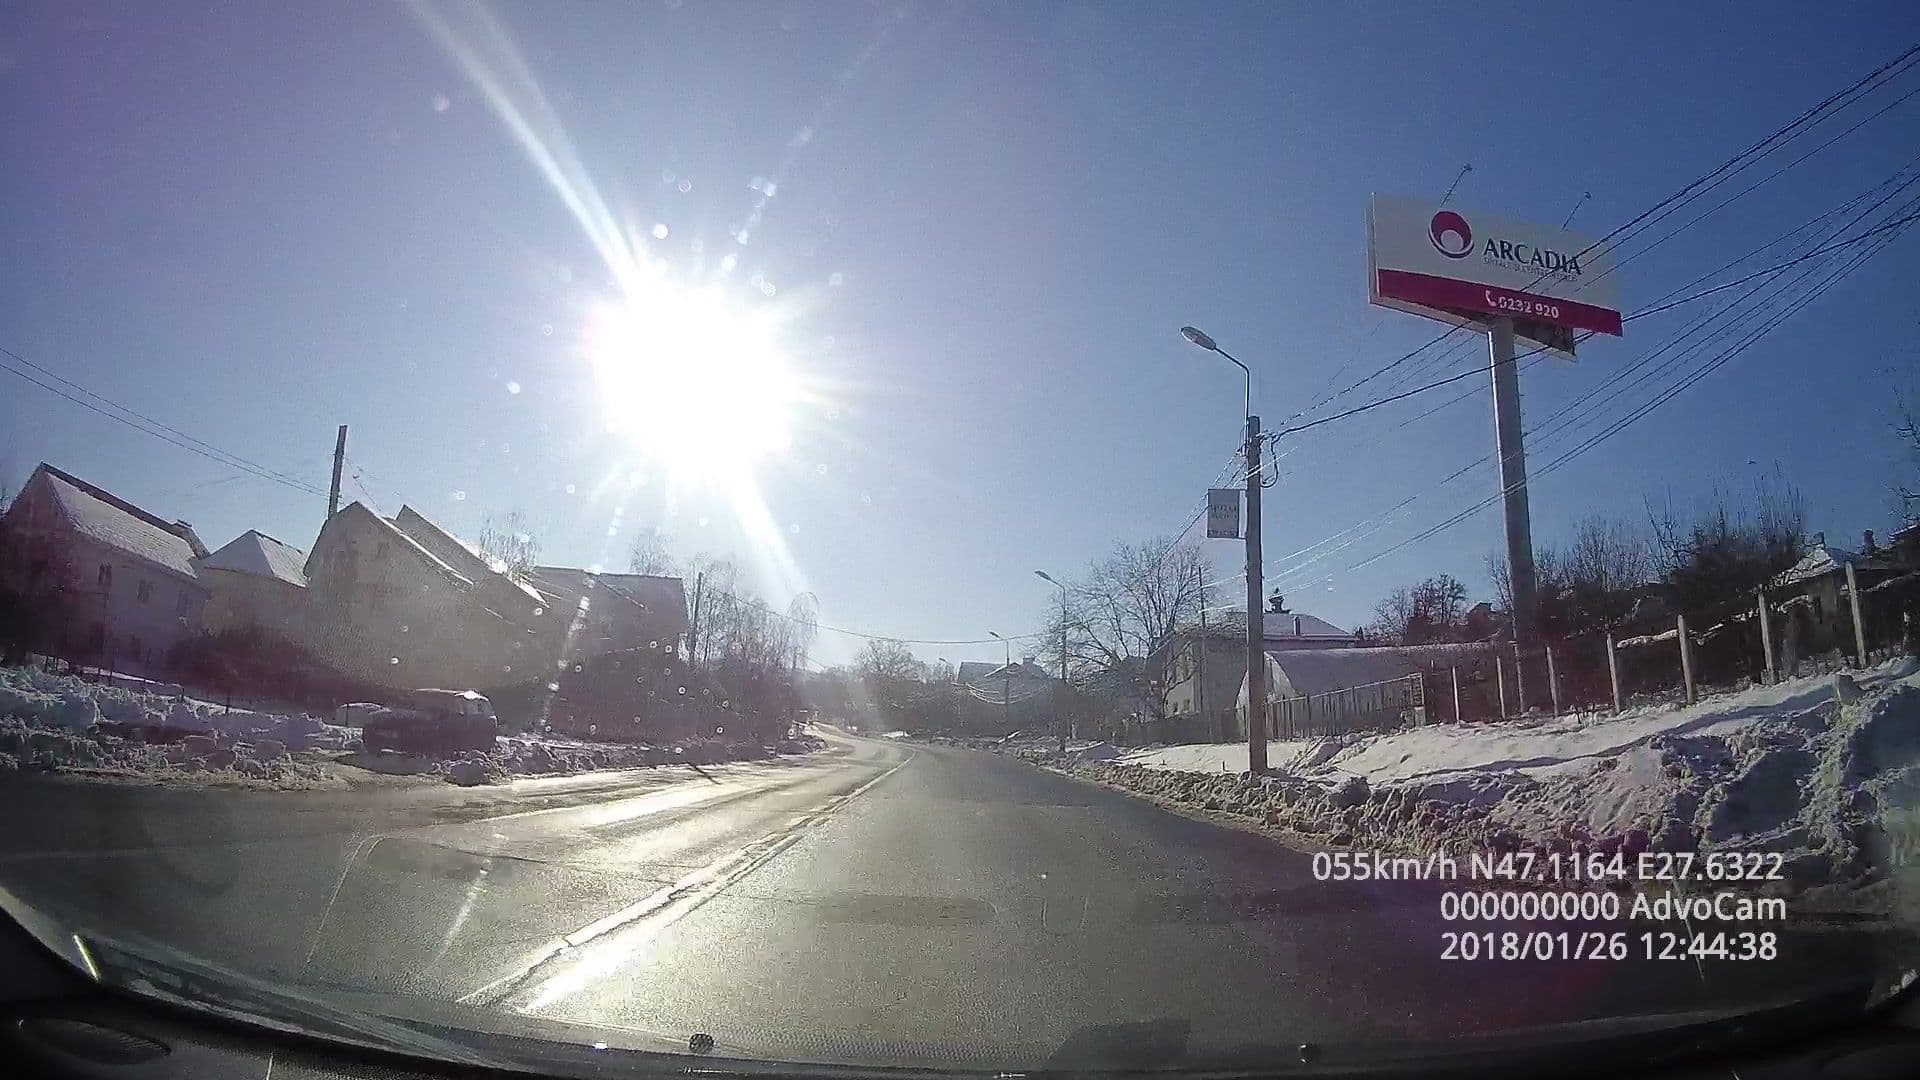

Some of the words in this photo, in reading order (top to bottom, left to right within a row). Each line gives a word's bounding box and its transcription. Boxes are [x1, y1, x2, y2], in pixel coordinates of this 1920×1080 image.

[1483, 238, 1582, 275] ARCADIA
[1498, 296, 1532, 314] 0232
[1535, 303, 1560, 319] 920
